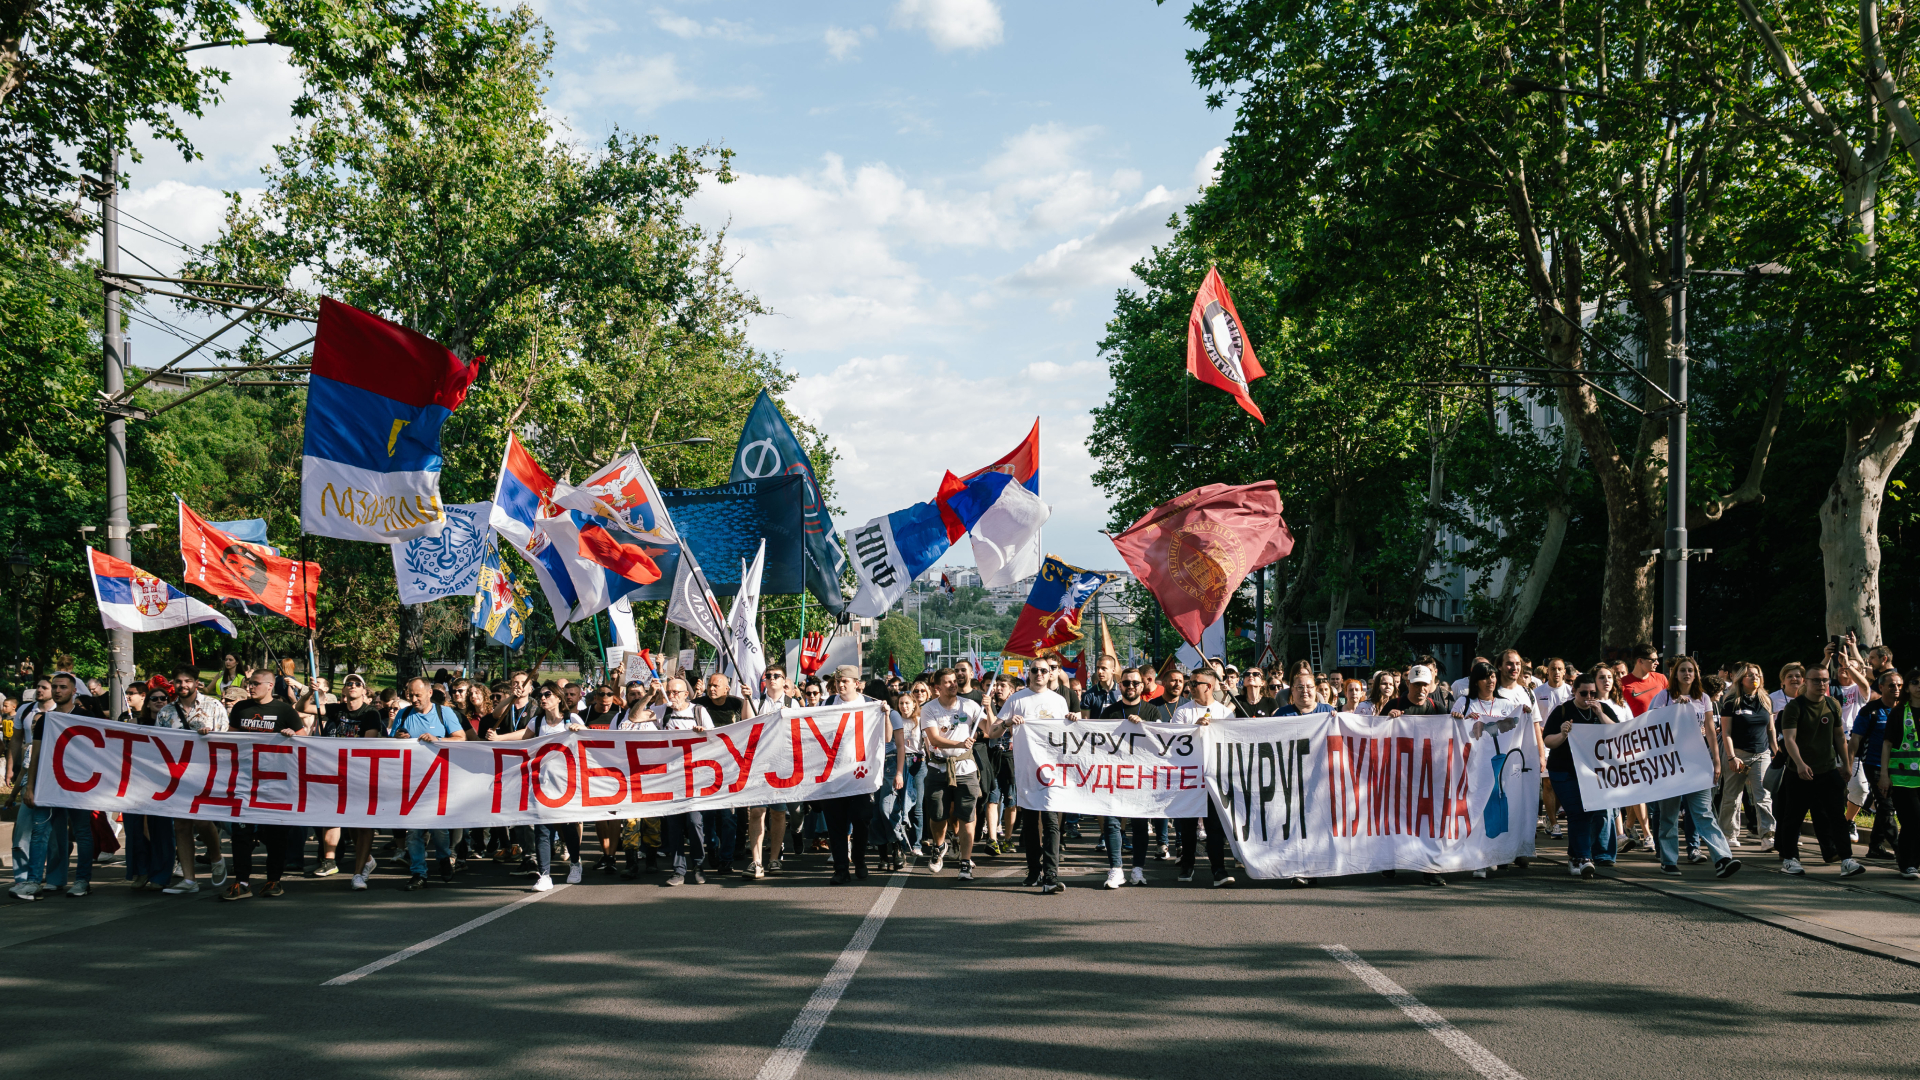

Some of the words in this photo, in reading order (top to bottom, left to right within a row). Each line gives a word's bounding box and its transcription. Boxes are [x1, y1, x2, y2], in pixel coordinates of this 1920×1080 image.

[1222, 308, 1242, 358] ДЕНТИ
[284, 561, 299, 615] ОЛУБАР
[413, 577, 427, 591] УЗ
[428, 568, 479, 595] СТУДЕНТЕ
[1048, 732, 1147, 756] ЧУРУГ
[1156, 734, 1194, 756] УЗ
[1594, 722, 1675, 762] СТУДЕНТИ
[52, 725, 450, 817] СТУДЕНТИ
[491, 710, 868, 814] ПОБЕЂУЈУ!
[1035, 763, 1206, 794] СТУДЕНТЕ!
[1594, 750, 1685, 789] ПОБЕЂУЈУ!
[1216, 738, 1310, 842] ЧУРУГ
